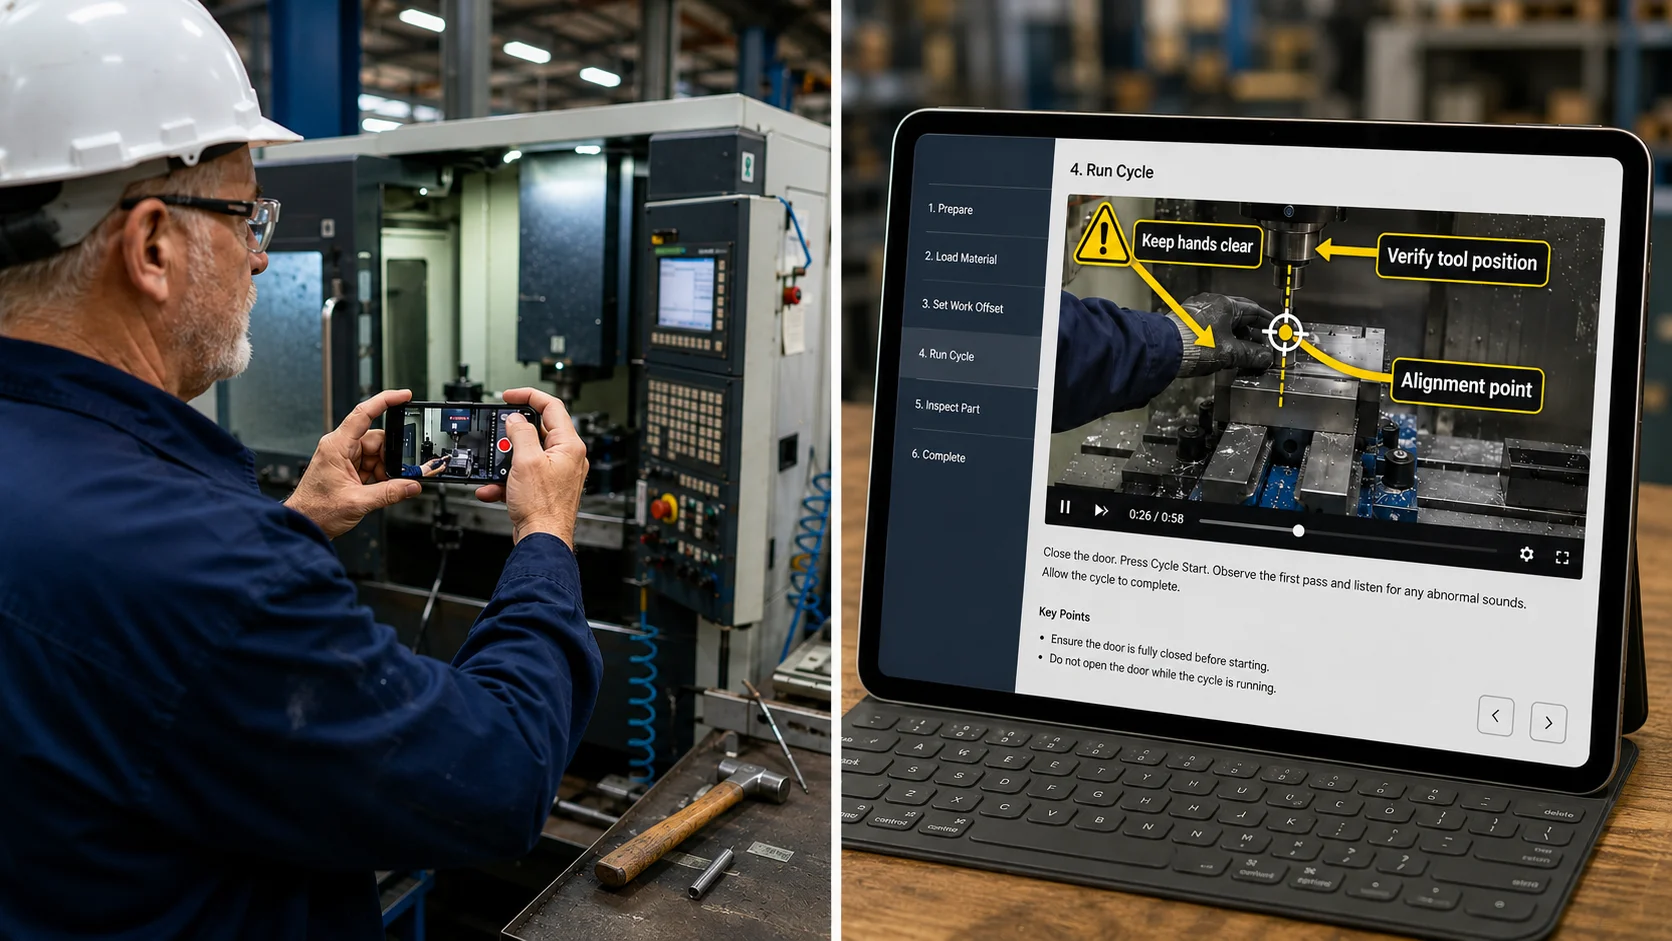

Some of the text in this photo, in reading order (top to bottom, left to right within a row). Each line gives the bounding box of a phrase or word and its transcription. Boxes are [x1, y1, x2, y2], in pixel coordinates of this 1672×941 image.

[1070, 163, 1154, 181] 4. Run Cycle
[929, 203, 973, 216] 1. Prepare
[1142, 233, 1253, 253] Keep hands clear
[925, 251, 997, 264] 2. Load Material
[1388, 247, 1537, 271] Verify tool position
[922, 299, 1003, 313] 3. Set Work Offset
[919, 348, 974, 362] 4. Run Cycle
[1401, 372, 1532, 399] Alignment point
[915, 399, 980, 414] 5. Inspect Part
[912, 449, 965, 463] 6. Complete
[1130, 509, 1184, 523] 0:26 / 0:58
[1042, 567, 1180, 591] Allow the cycle to complete.
[1044, 547, 1526, 609] Close the door. Press Cycle Start. Observe the first pass and listen for any abnormal sounds.
[1039, 606, 1090, 622] Key Points
[1052, 634, 1269, 673] Ensure the door is fully closed before starting.
[1050, 653, 1276, 695] Do not open the door while the cycle is running.
